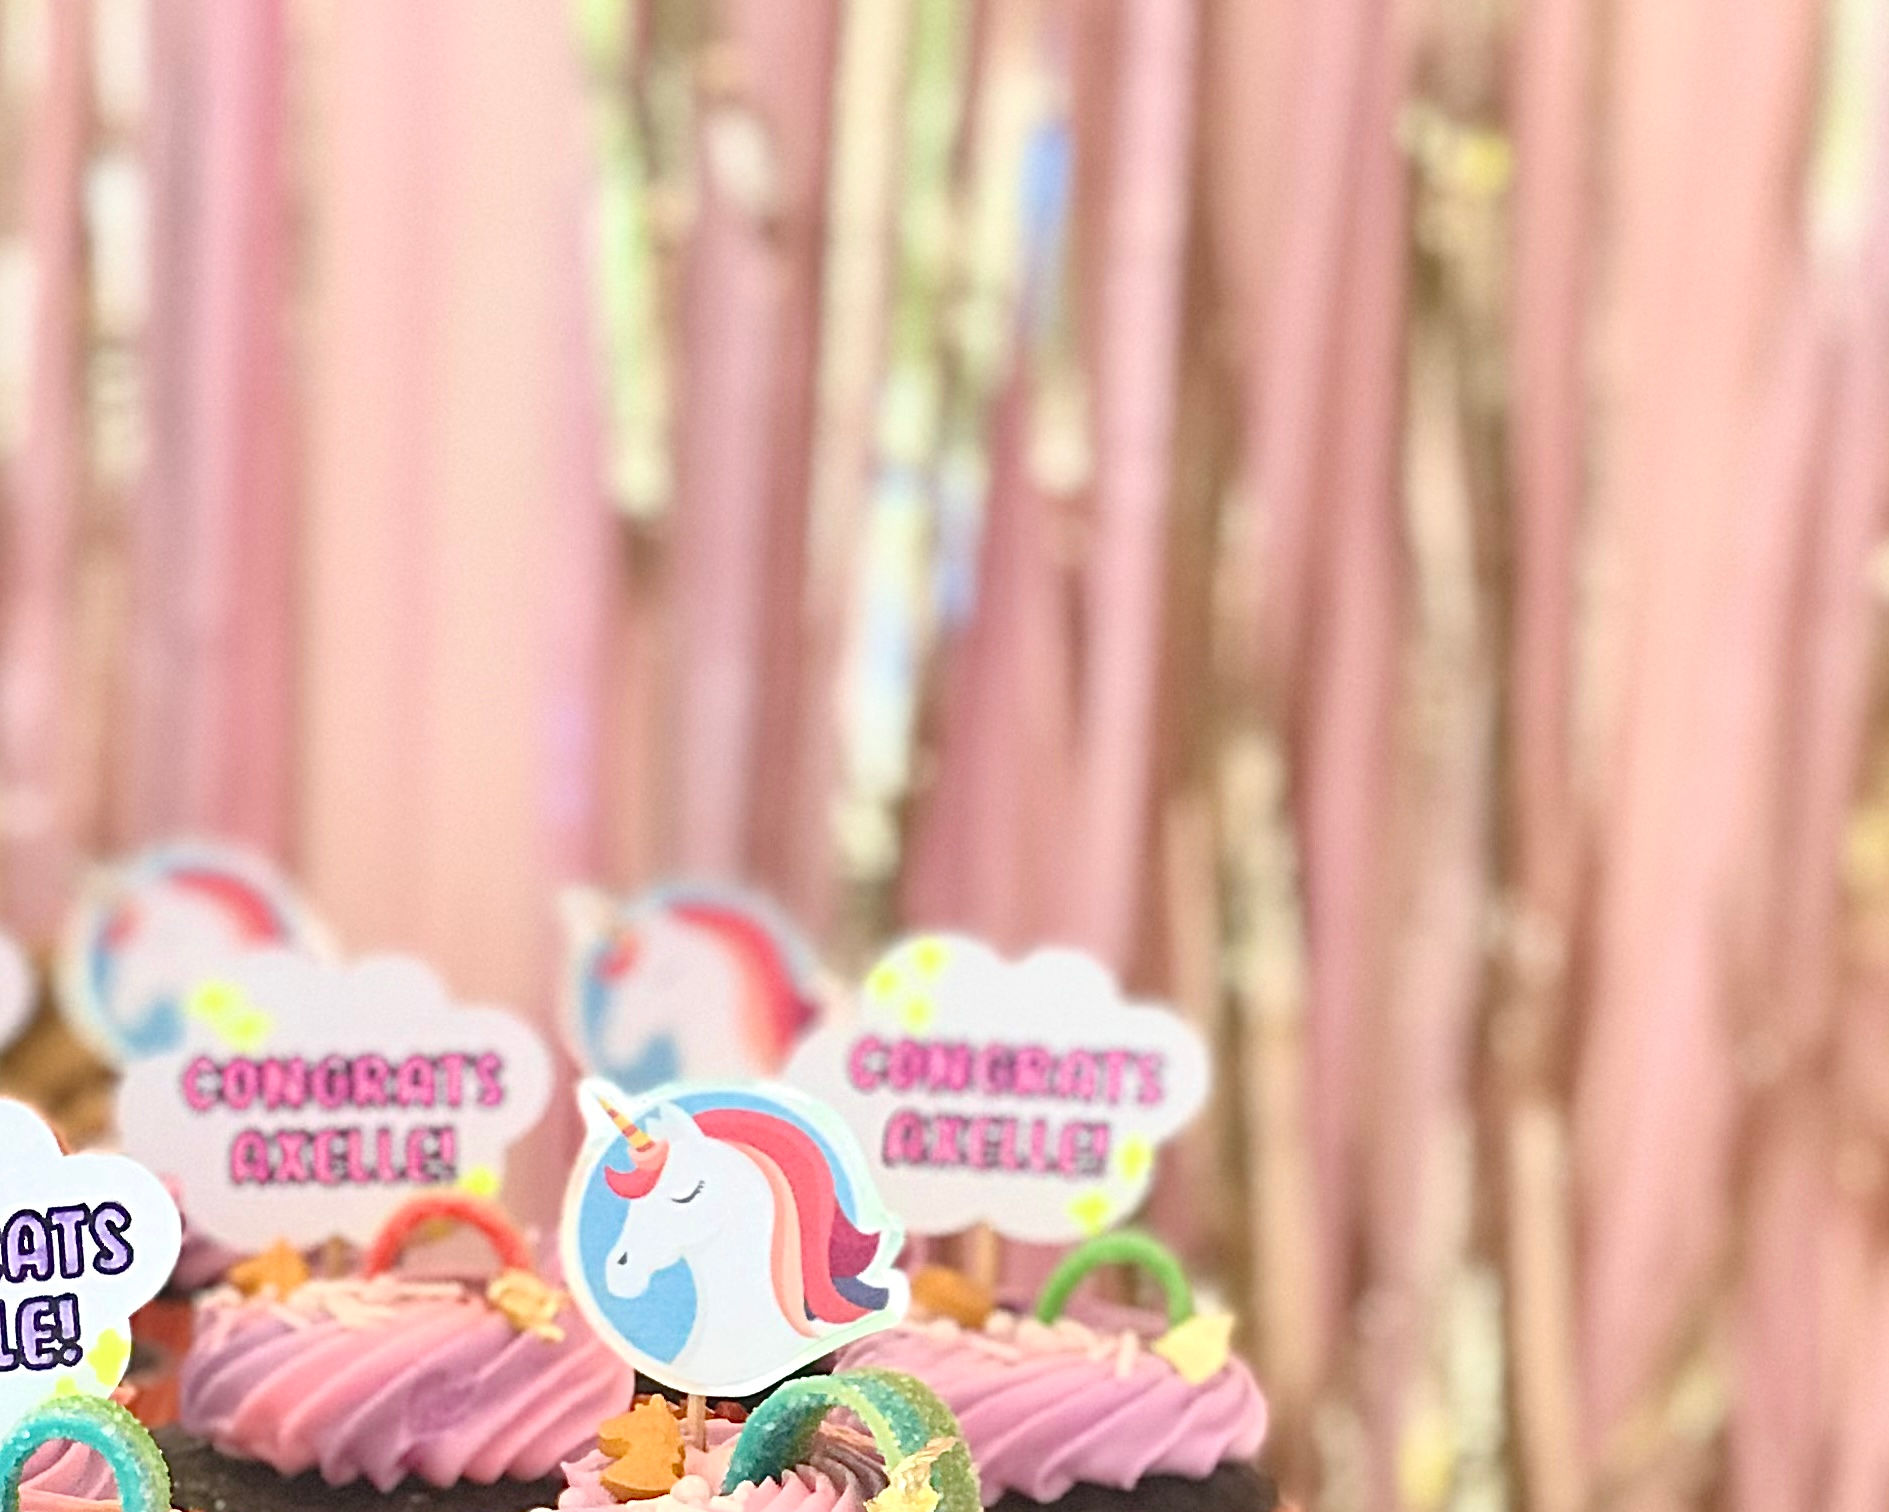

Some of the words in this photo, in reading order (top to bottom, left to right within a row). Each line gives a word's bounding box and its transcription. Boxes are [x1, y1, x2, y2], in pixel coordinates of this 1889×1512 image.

[182, 1051, 504, 1111] CONGRATS
[847, 1035, 1165, 1107] CONGRATS
[229, 1125, 458, 1187] AXELLE!
[881, 1107, 1110, 1179] AXELLE!
